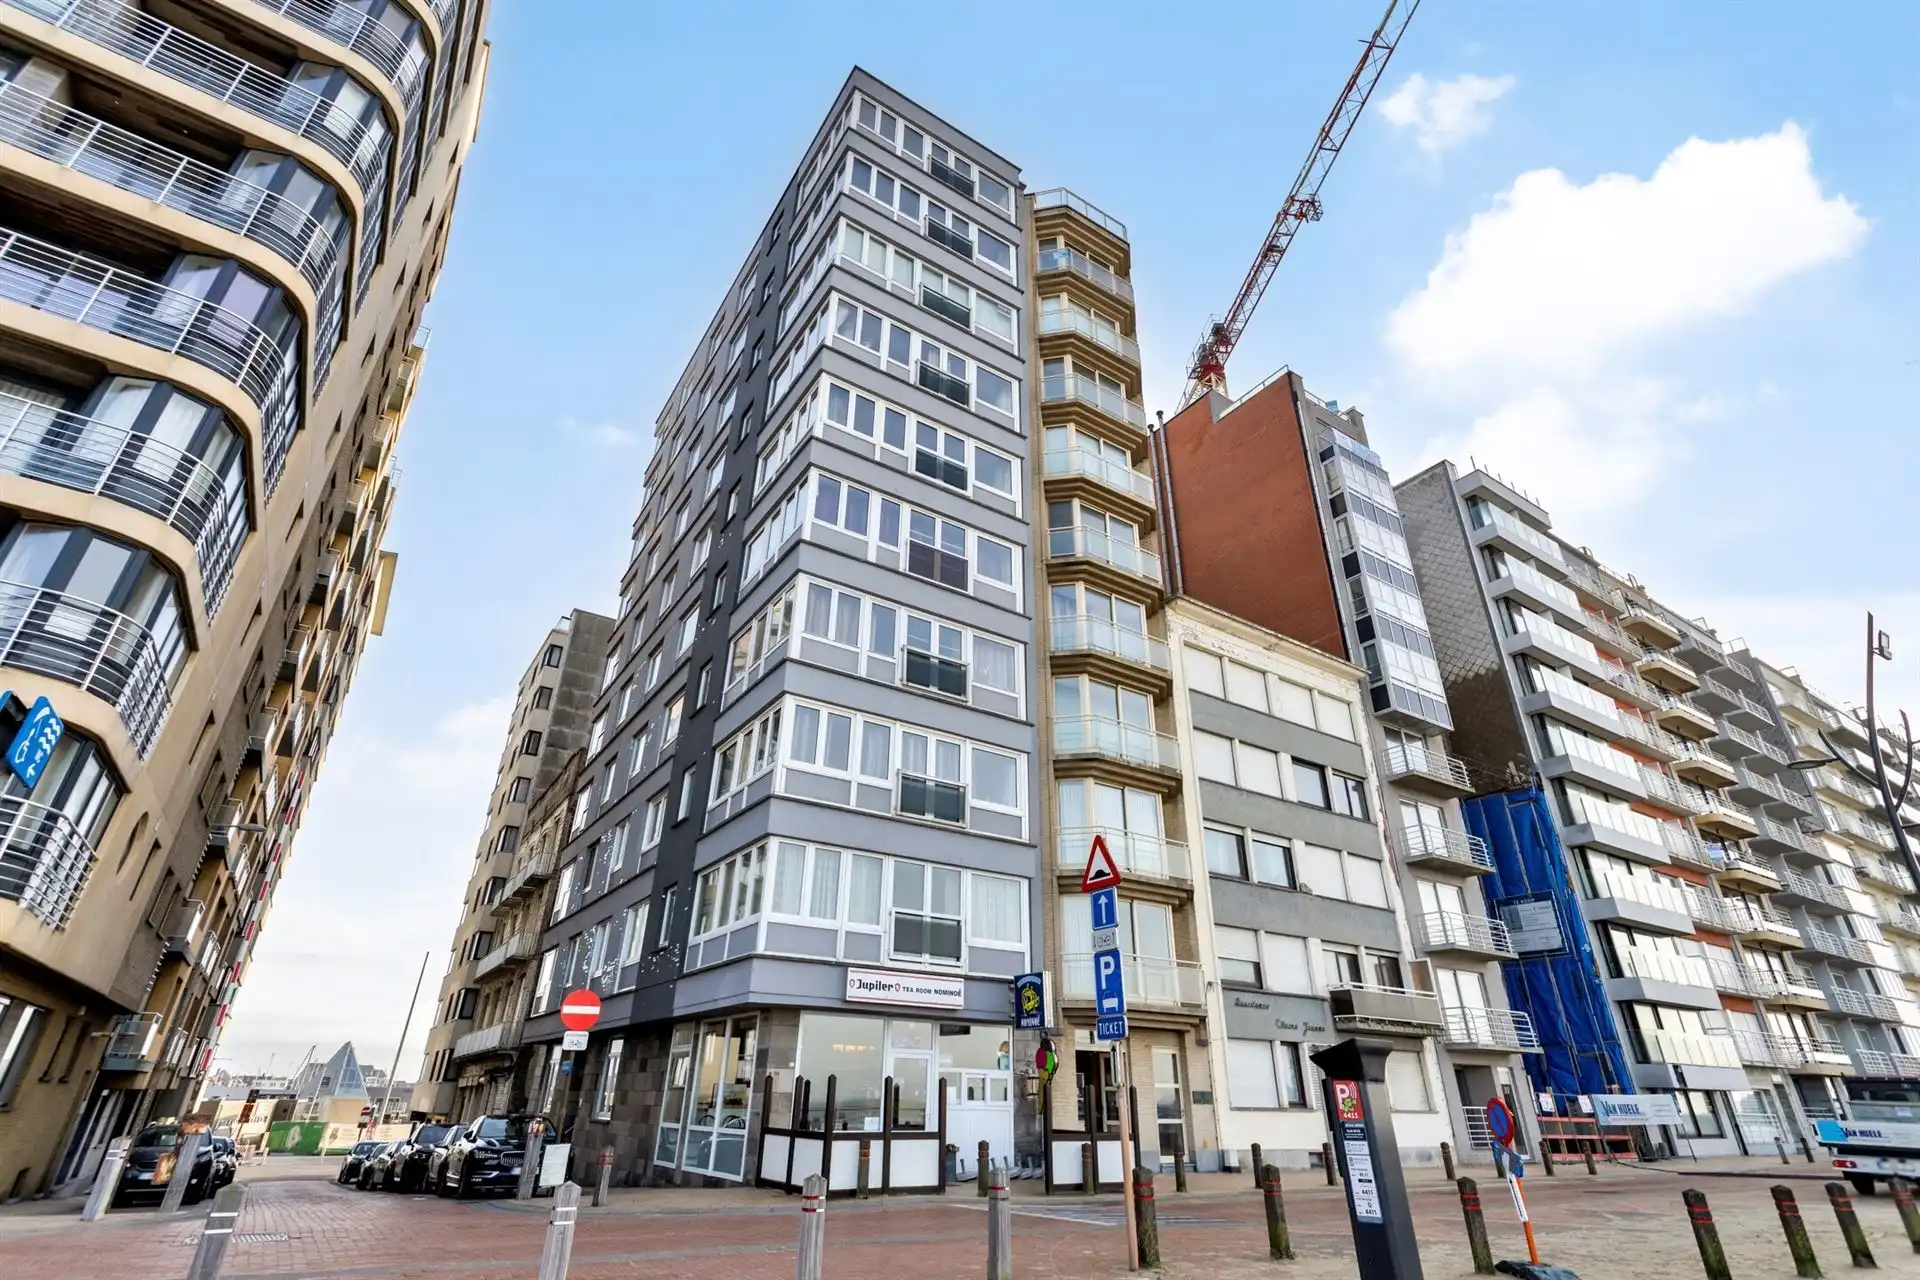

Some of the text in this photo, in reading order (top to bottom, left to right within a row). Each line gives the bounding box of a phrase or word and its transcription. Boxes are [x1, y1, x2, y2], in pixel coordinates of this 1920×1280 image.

[1100, 955, 1115, 990] P
[856, 979, 893, 992] Jupiler
[916, 987, 932, 995] ROOM
[1099, 1021, 1123, 1036] TICKET
[1600, 1100, 1618, 1117] VAN
[1617, 1103, 1640, 1115] HUELE
[1840, 1127, 1858, 1138] VAN
